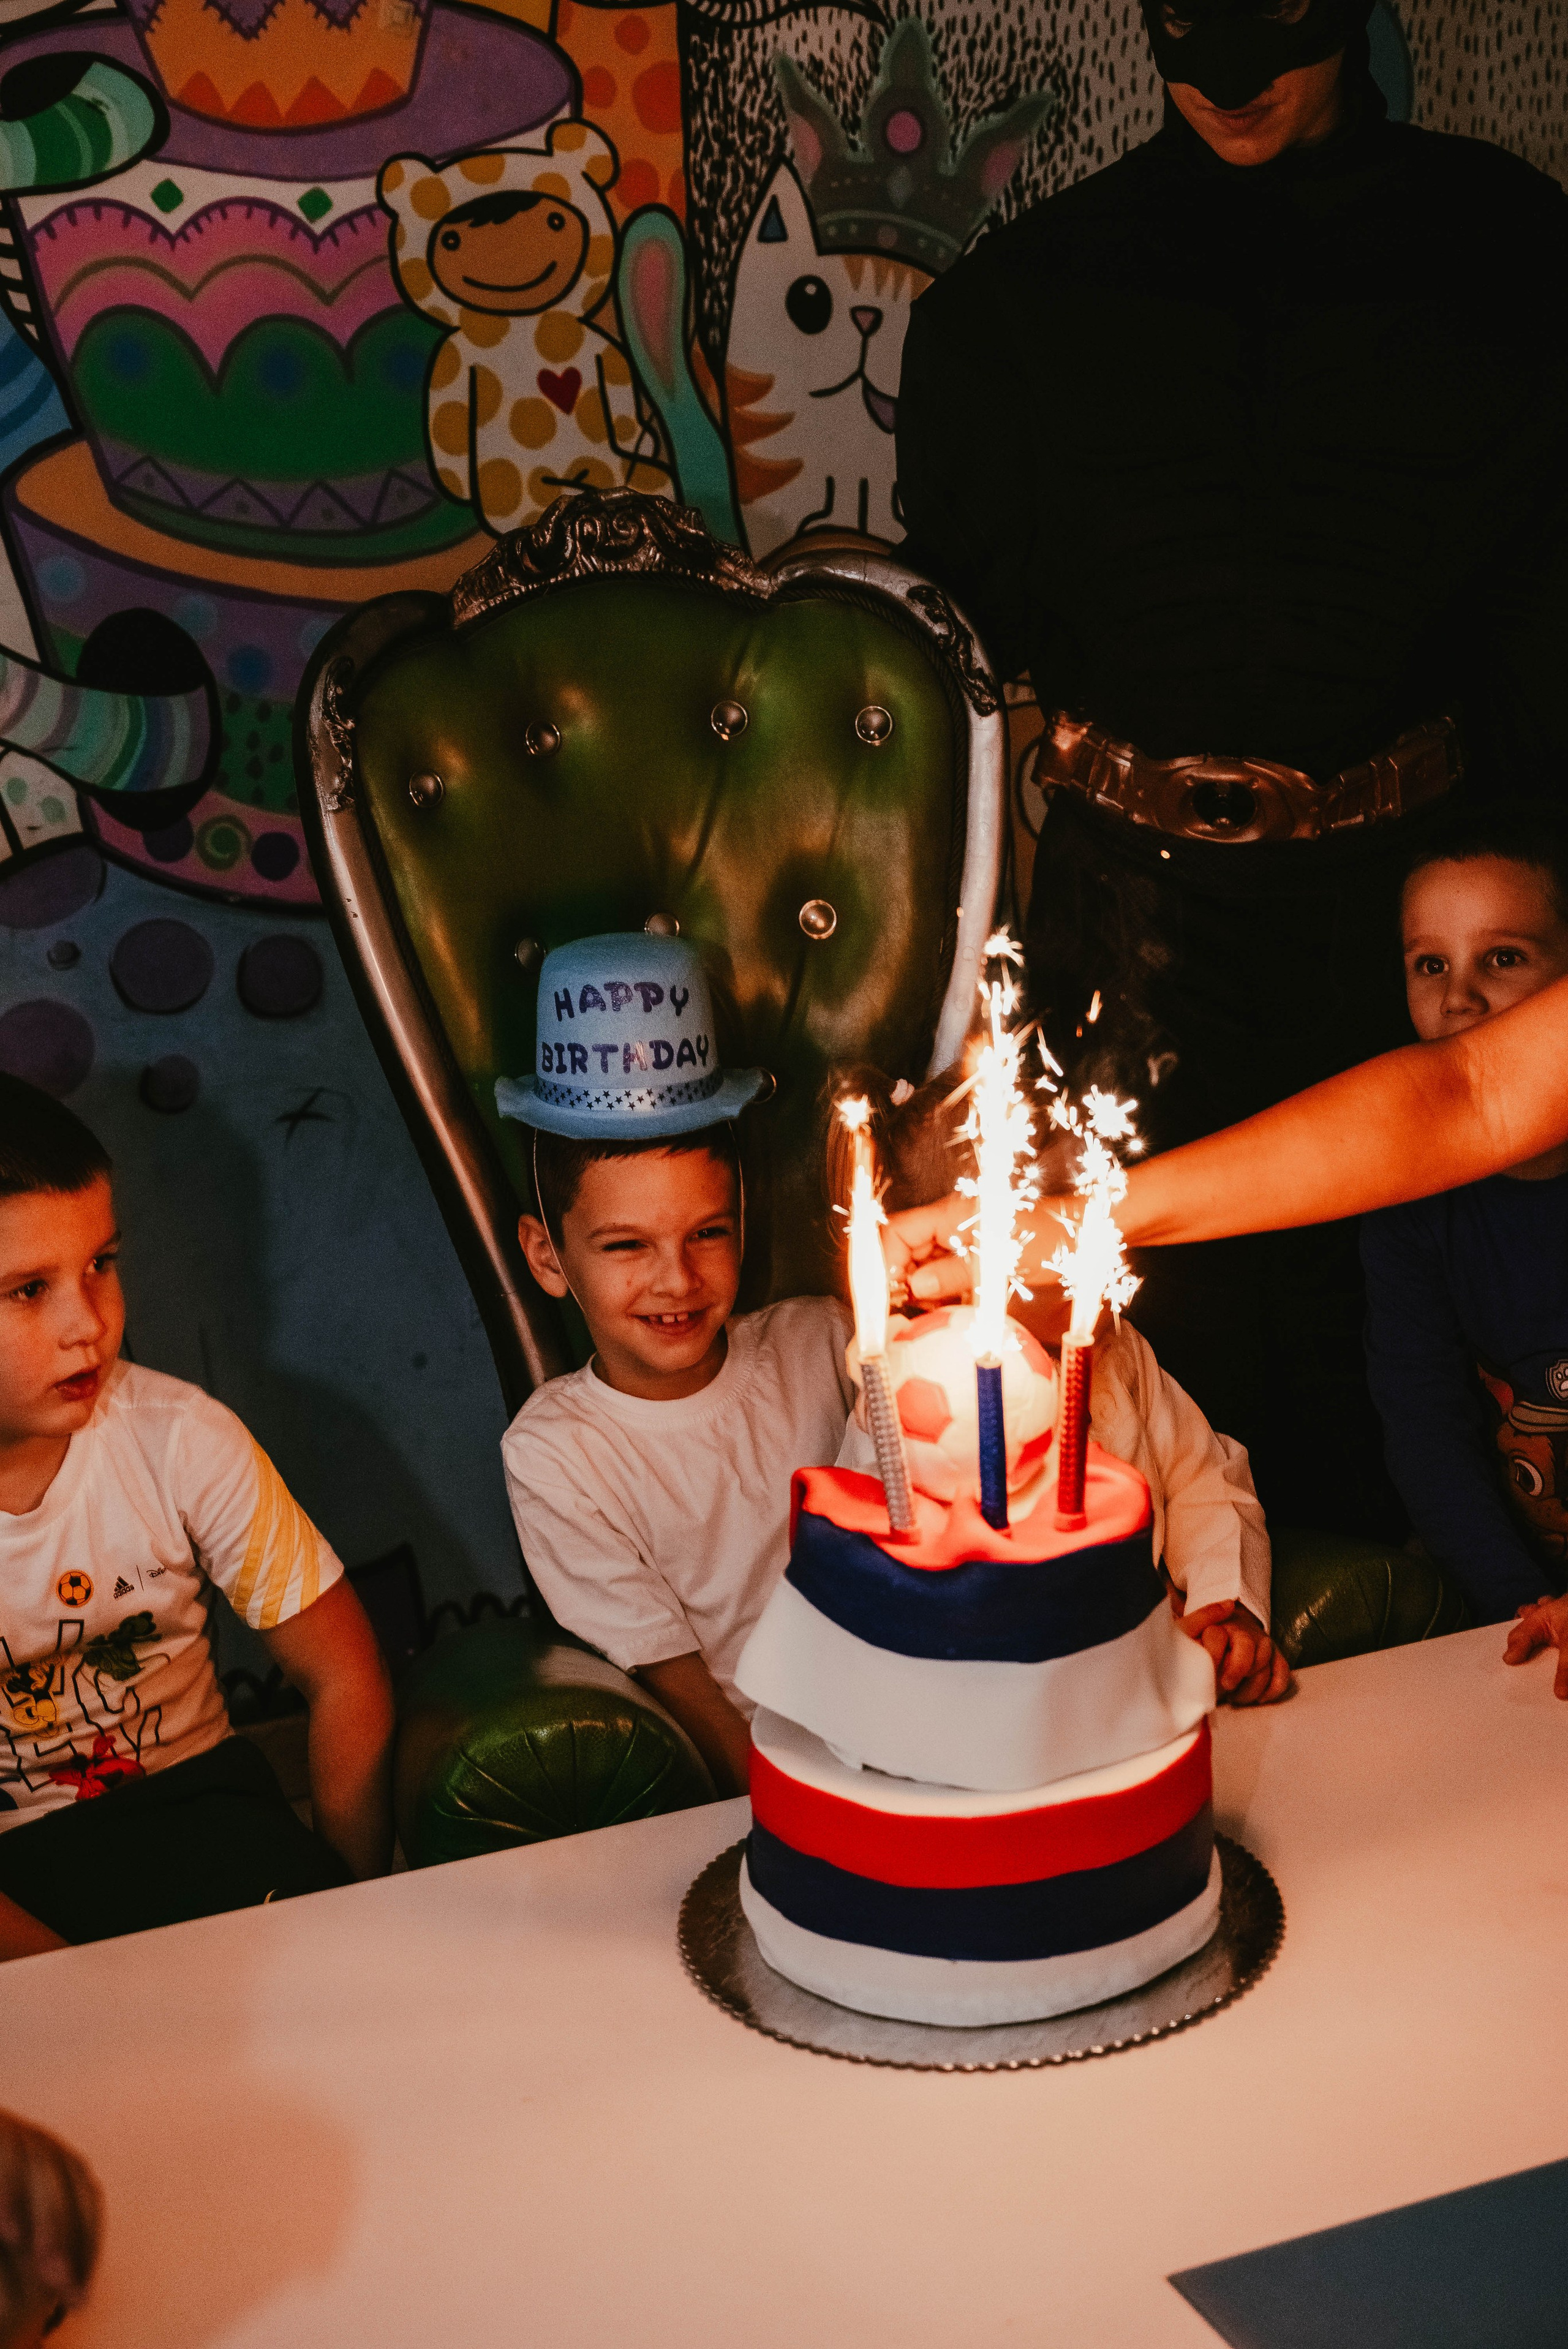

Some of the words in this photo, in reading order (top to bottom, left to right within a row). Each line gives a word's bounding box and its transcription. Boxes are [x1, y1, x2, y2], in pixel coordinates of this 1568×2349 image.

[554, 981, 689, 1022] HAPPY
[541, 1034, 709, 1074] BIRTHDAY
[113, 1584, 135, 1599] adidas
